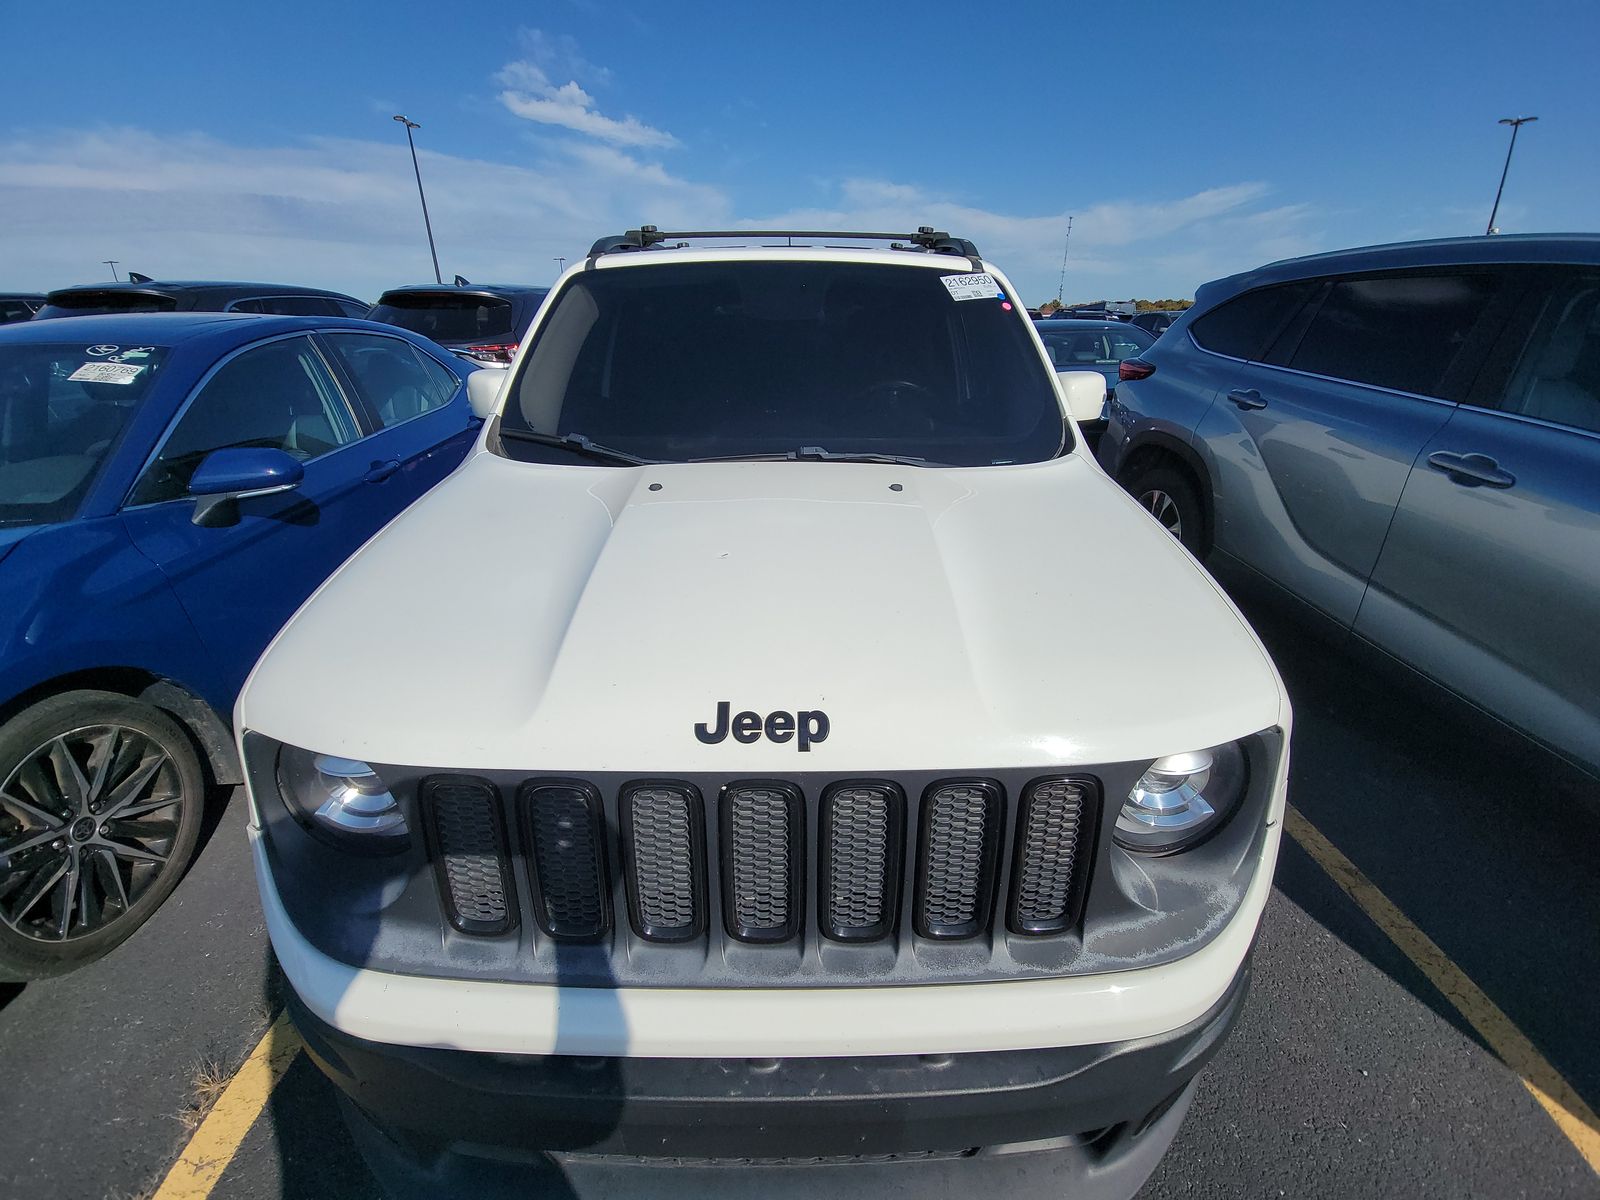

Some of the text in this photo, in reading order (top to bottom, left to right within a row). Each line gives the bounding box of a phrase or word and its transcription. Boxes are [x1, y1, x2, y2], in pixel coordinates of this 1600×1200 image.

[945, 275, 992, 287] 2162950
[84, 364, 139, 375] 2160769
[694, 701, 830, 752] Jeep
